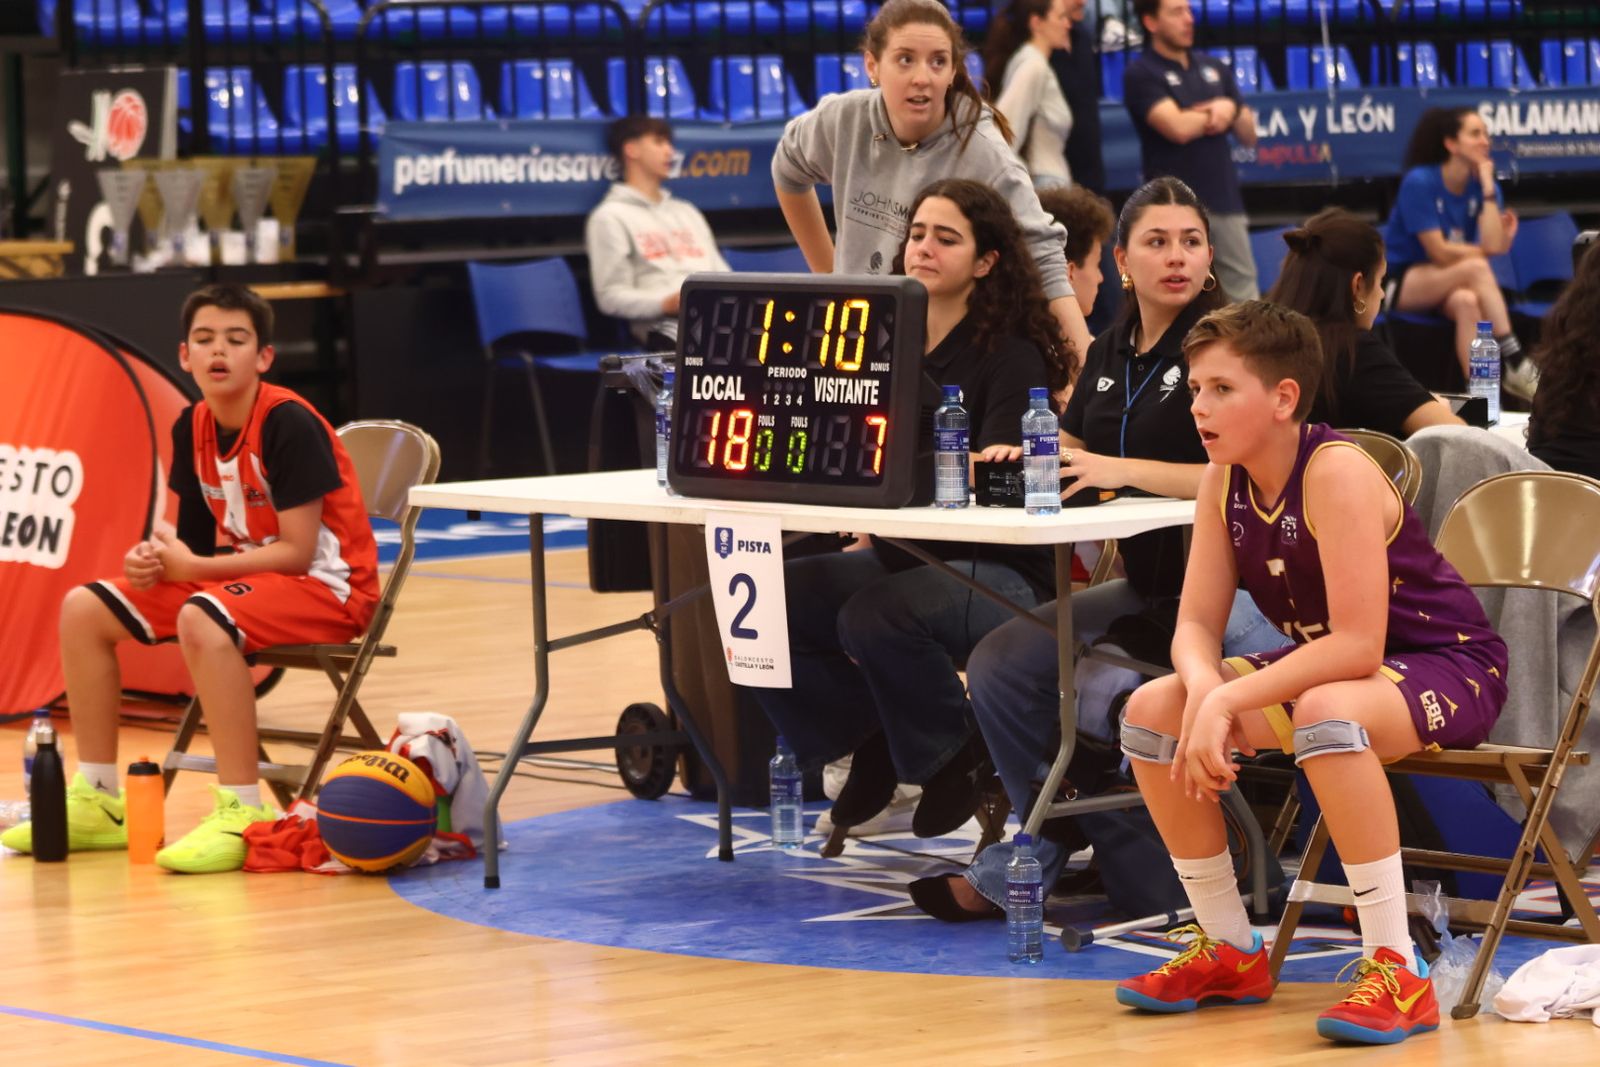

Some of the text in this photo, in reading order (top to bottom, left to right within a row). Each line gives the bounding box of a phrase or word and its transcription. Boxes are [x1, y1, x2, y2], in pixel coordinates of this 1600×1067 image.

[1298, 106, 1317, 141] Y
[1326, 95, 1395, 134] LEÓN
[685, 357, 704, 367] BONUS
[767, 366, 807, 378] PERIODO
[870, 362, 890, 372] BONUS
[692, 375, 746, 401] LOCAL
[814, 377, 880, 405] VISITANTE
[762, 393, 803, 406] 1 2 3 4
[757, 415, 775, 427] FOULS
[790, 416, 808, 428] FOULS
[707, 409, 754, 471] 18
[865, 415, 888, 475] 7
[0, 511, 63, 555] EON
[737, 539, 772, 554] PISTA
[728, 572, 759, 640] 2
